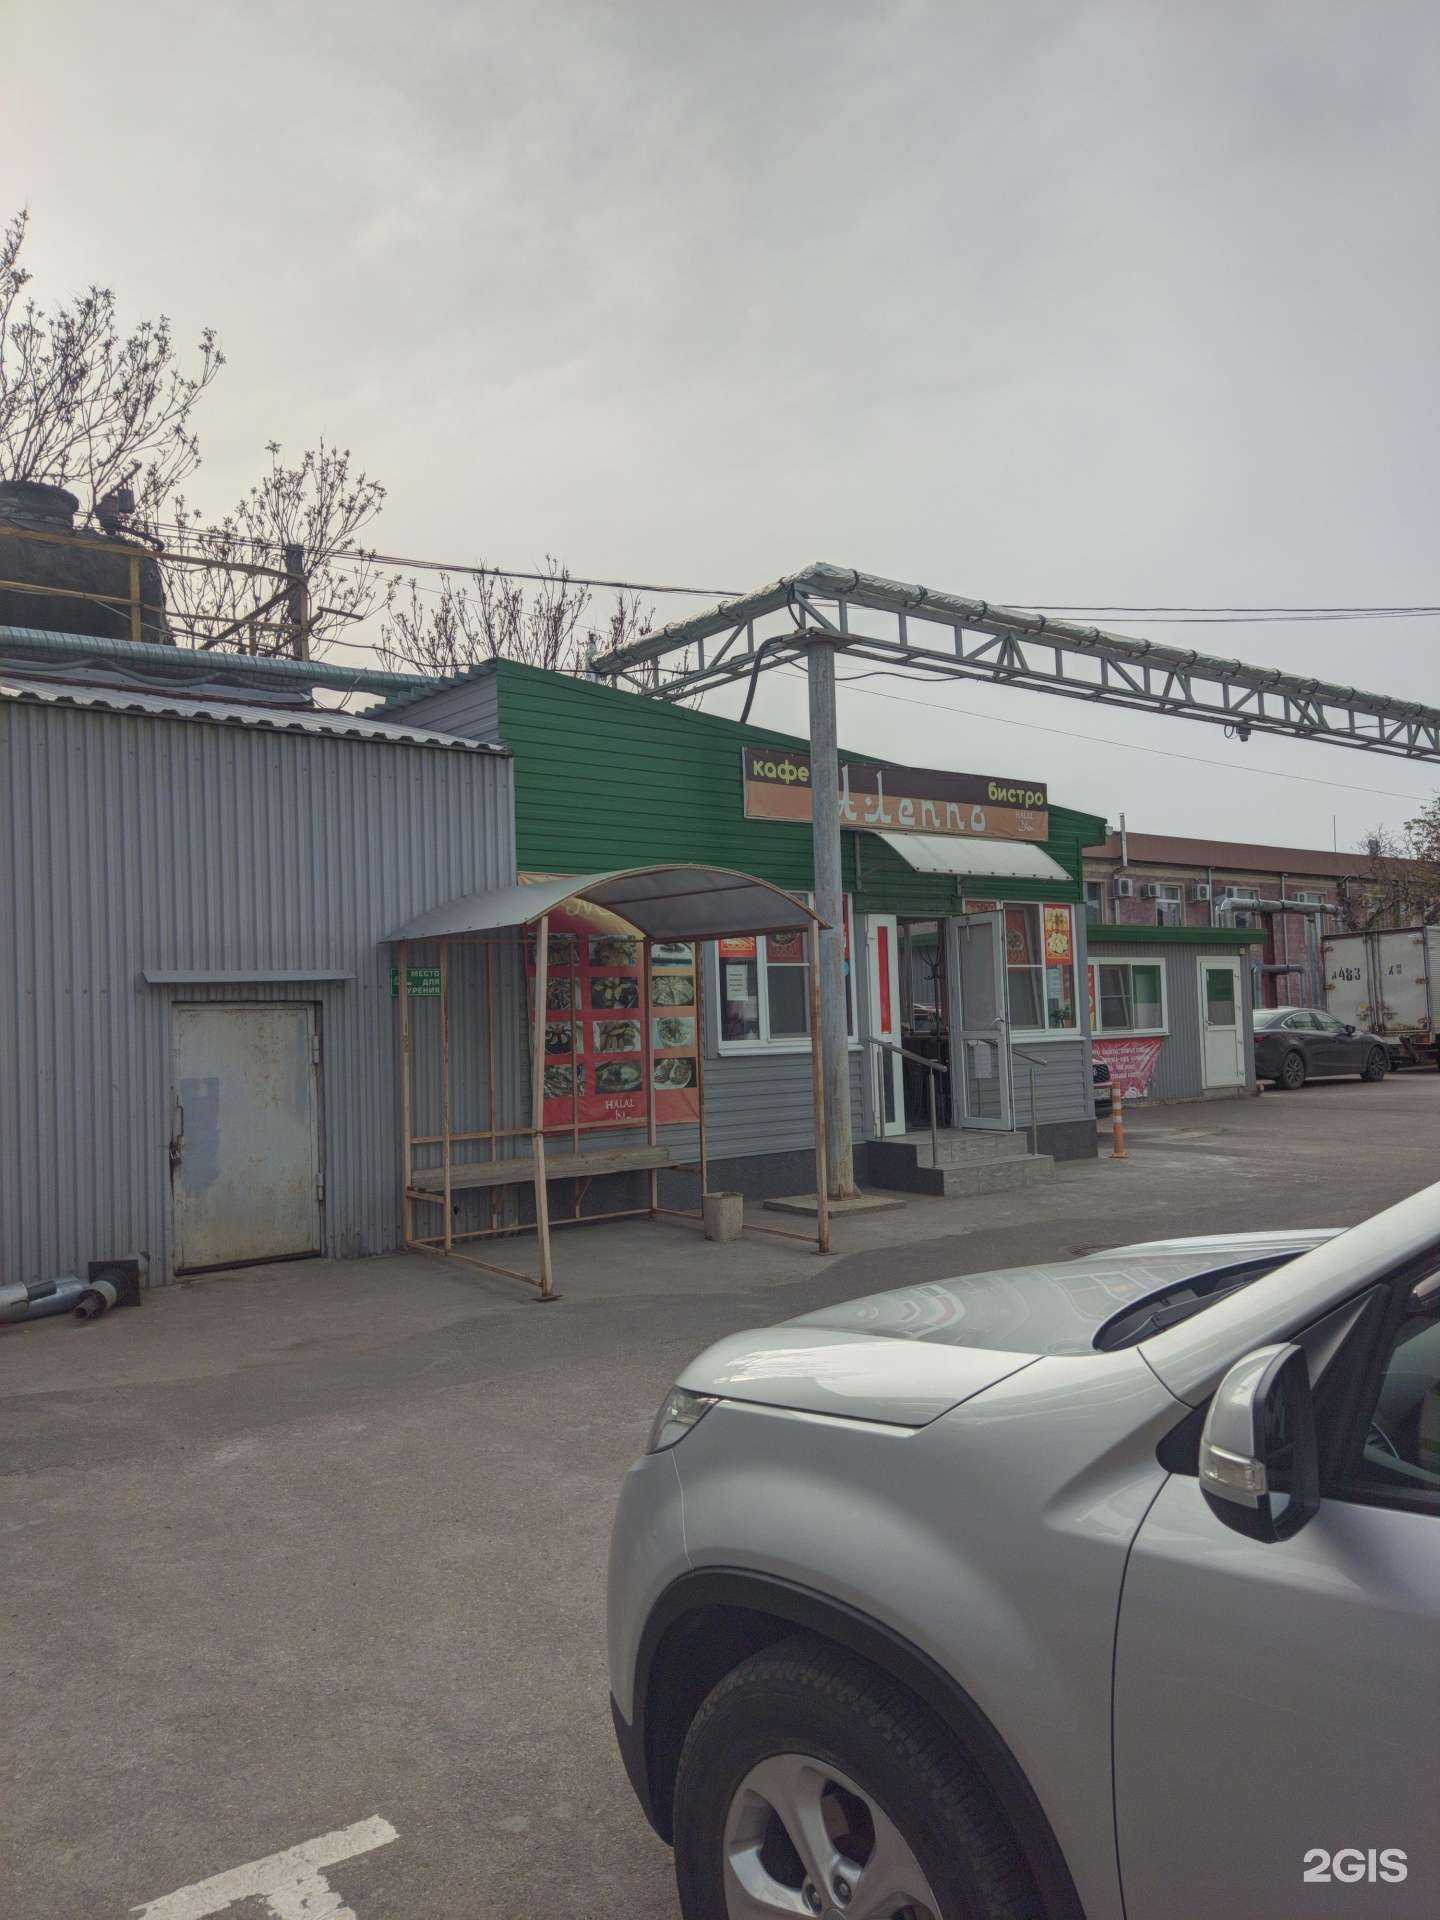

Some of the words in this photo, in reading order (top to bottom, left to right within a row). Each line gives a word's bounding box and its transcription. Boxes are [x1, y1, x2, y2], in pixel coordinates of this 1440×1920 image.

[752, 759, 810, 785] кафе
[987, 781, 1045, 808] бистро
[407, 986, 440, 994] УРЕНИЯ
[422, 978, 440, 986] ДЛЯ
